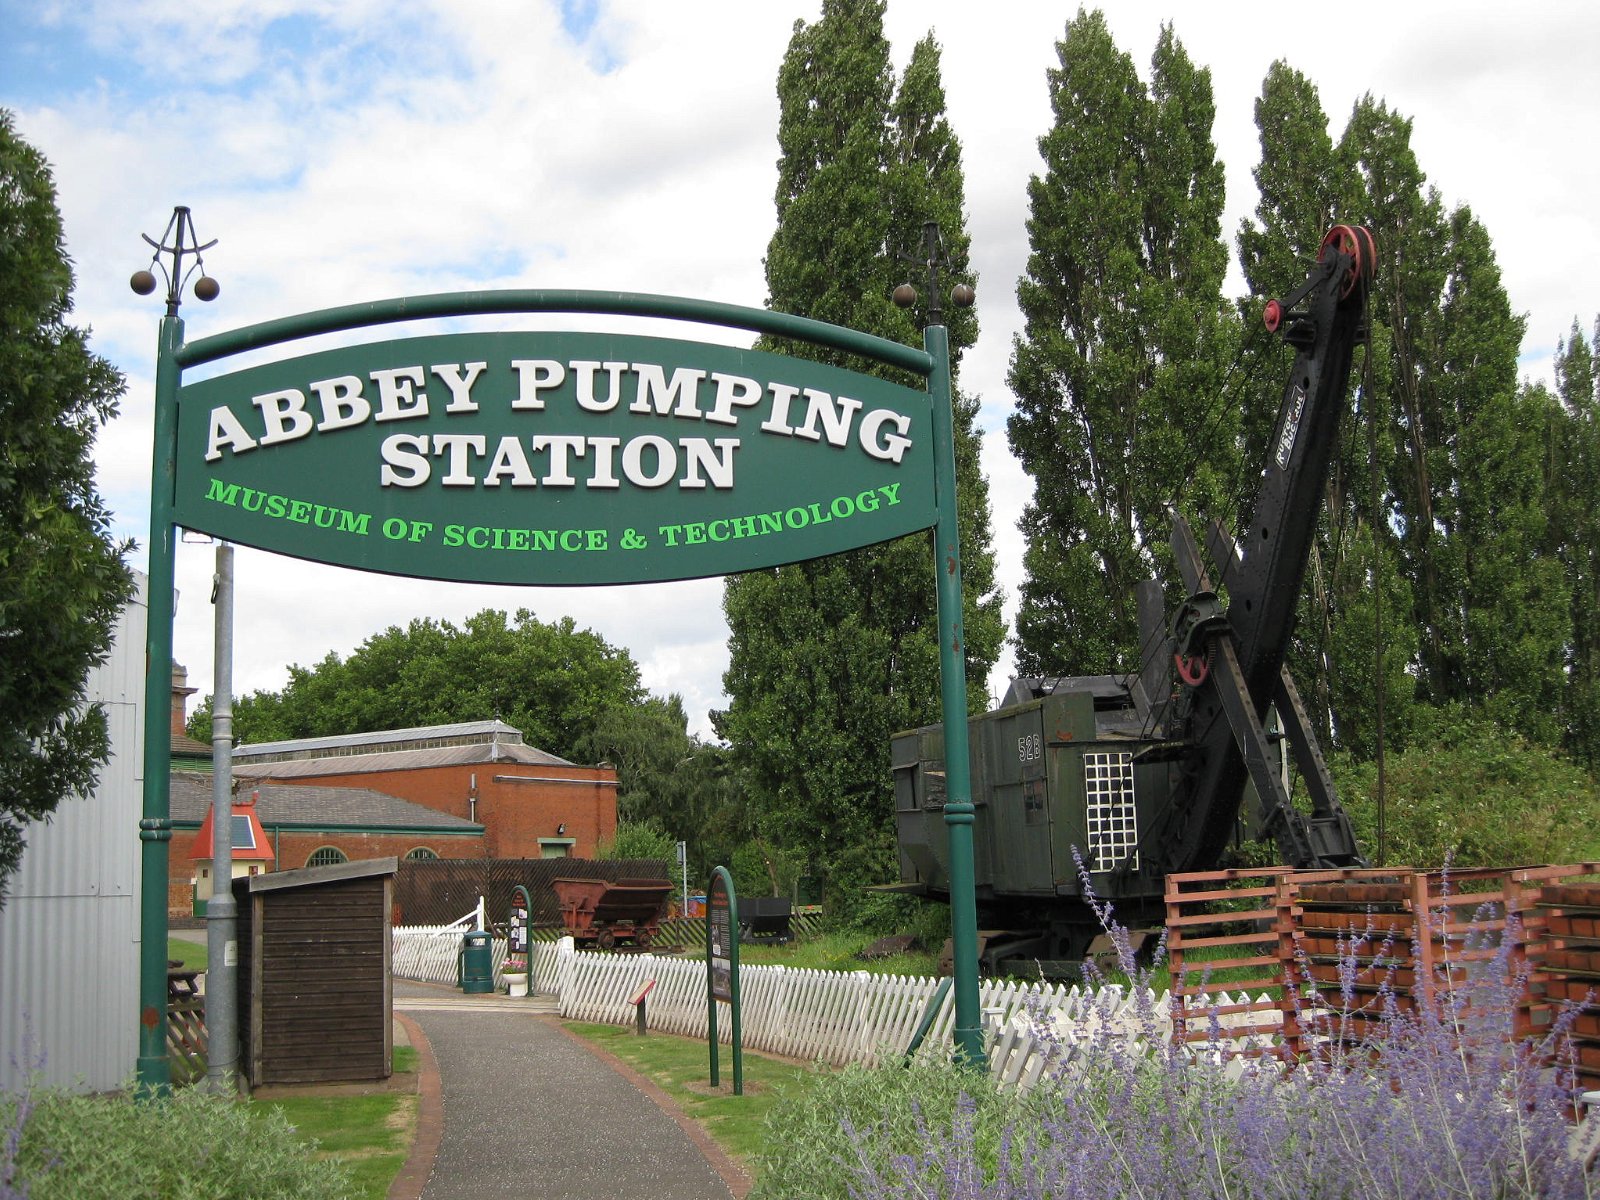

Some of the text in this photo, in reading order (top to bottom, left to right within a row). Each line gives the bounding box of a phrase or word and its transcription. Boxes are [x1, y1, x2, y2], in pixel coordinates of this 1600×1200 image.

[204, 359, 913, 464] ABBEY PUMPING
[1276, 411, 1292, 465] RUSTON
[1284, 396, 1304, 450] BUCRUS
[380, 433, 740, 489] STATION
[204, 478, 902, 551] MUSEUM OF SCIENCE & TECHNOLOGY
